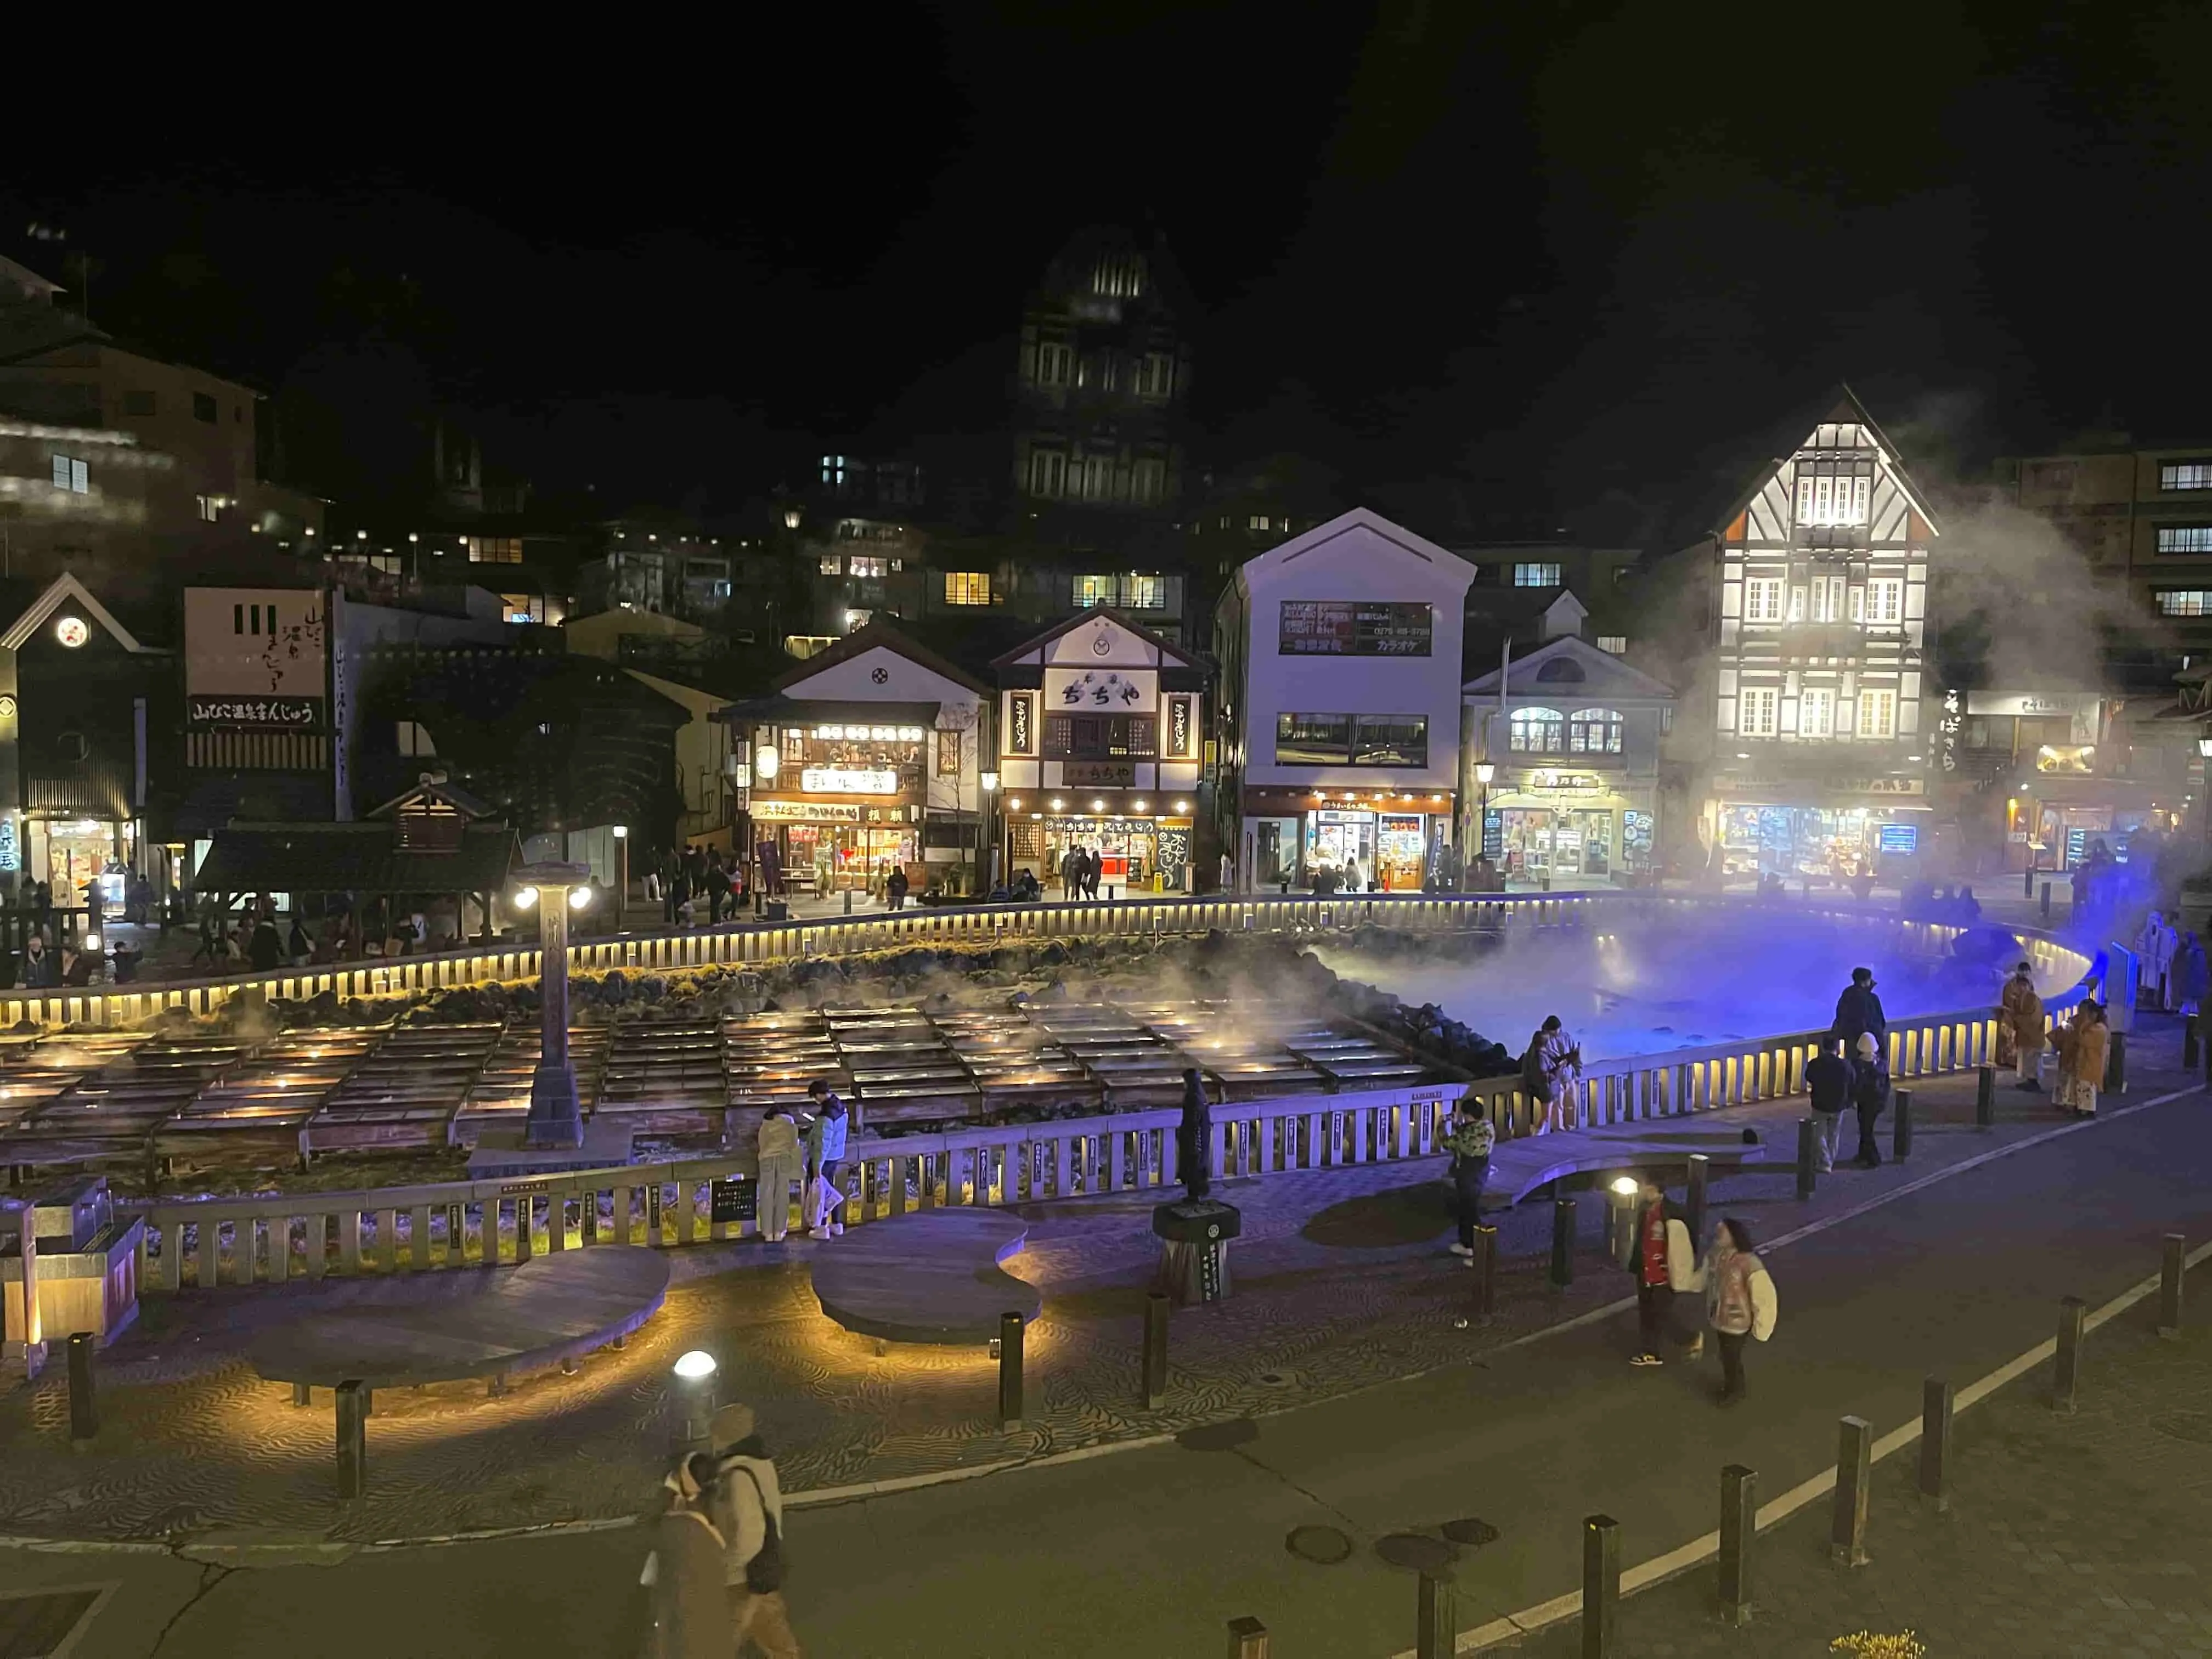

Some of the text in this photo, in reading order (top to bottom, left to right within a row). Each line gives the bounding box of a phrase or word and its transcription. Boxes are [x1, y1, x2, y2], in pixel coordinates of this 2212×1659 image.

[1062, 685, 1140, 707] ちちや
[193, 702, 313, 723] 山びこ温泉まんじゅう
